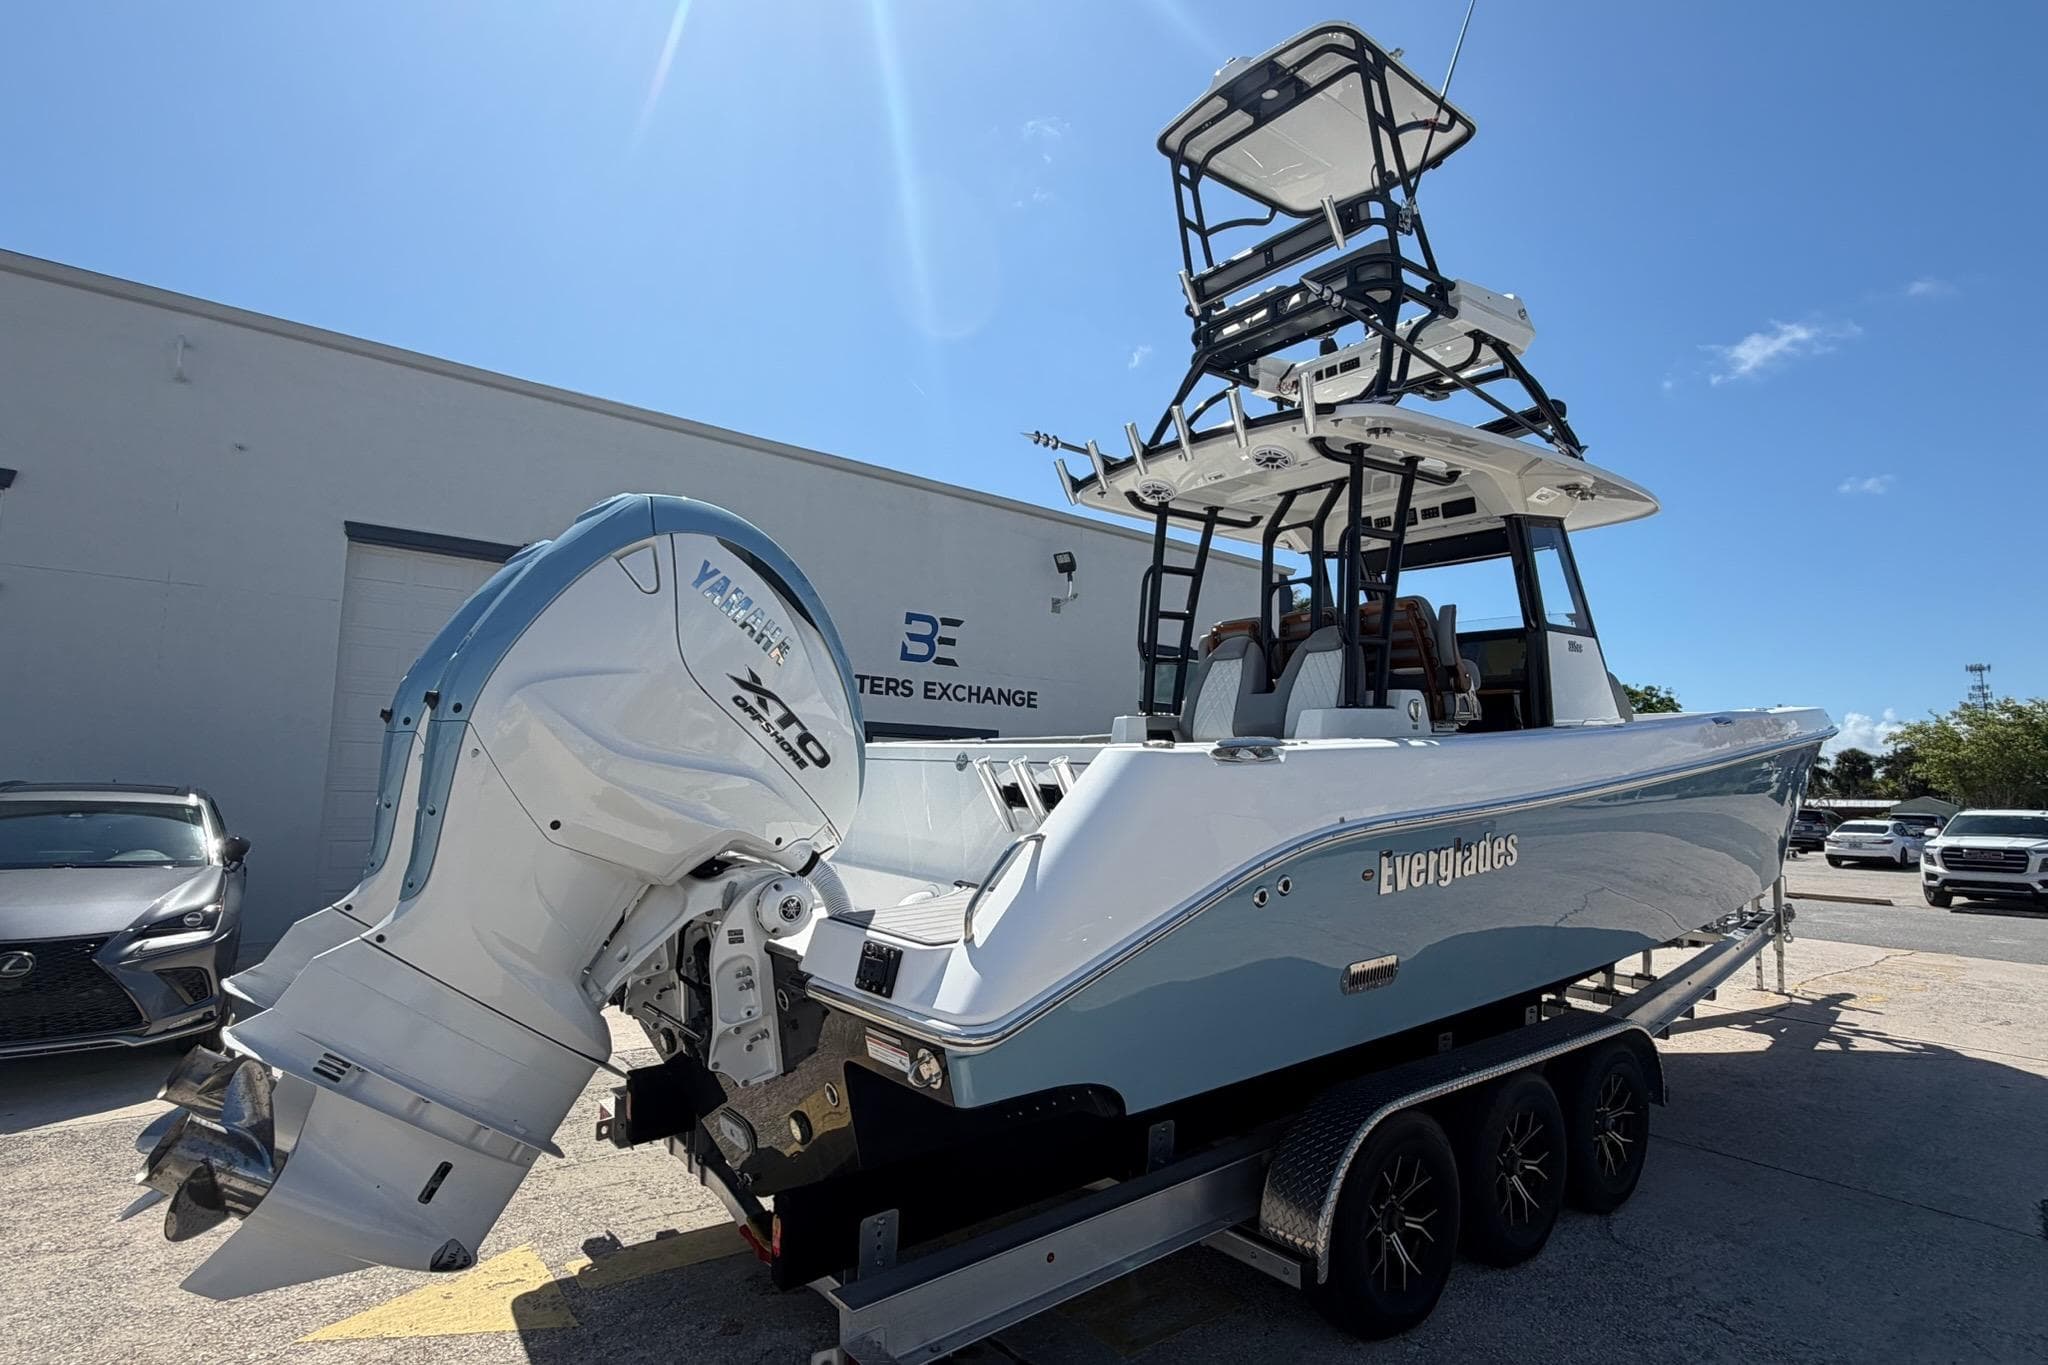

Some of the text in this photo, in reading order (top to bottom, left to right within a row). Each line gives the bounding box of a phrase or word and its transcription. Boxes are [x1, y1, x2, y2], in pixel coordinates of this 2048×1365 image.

[691, 560, 793, 666] YAMAHA
[725, 664, 831, 769] XTO
[731, 695, 809, 771] OFFSHORE
[923, 681, 1038, 709] EXCHANGE
[1378, 832, 1518, 895] Everglades
